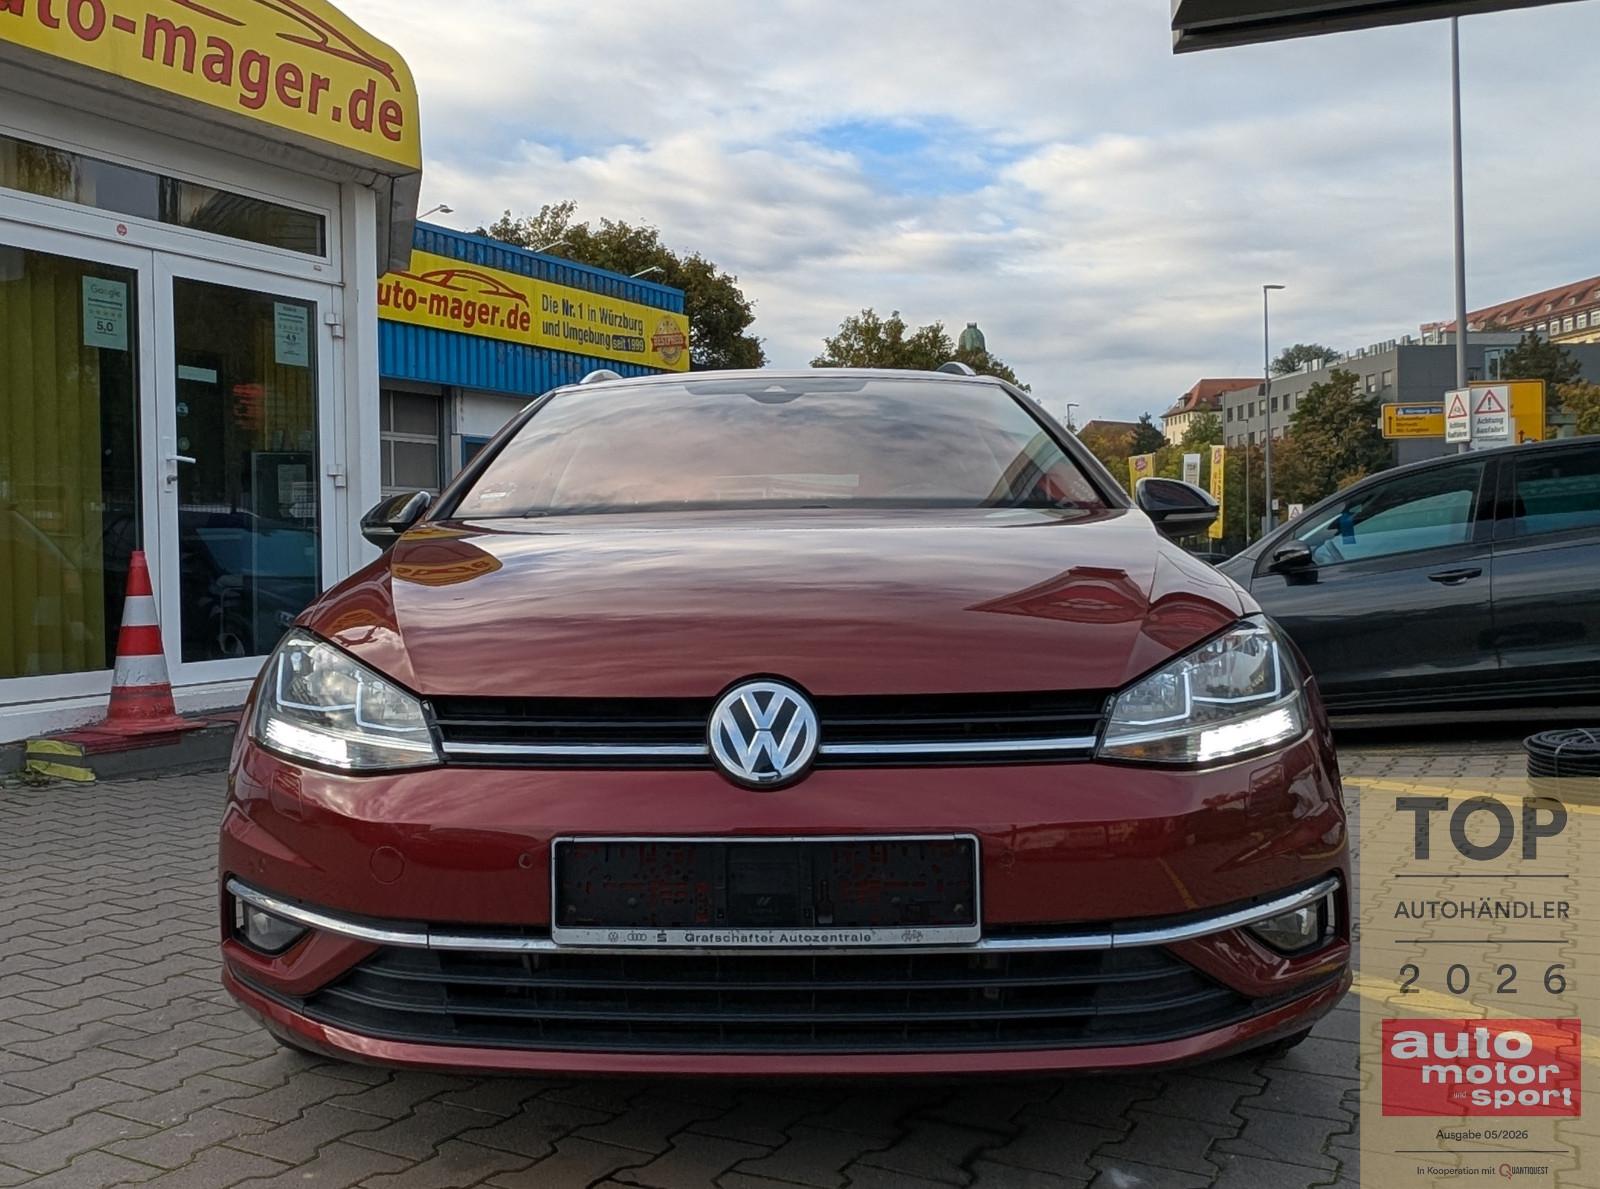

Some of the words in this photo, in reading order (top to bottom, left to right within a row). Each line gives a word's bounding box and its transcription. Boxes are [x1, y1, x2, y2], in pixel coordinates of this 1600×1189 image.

[541, 294, 559, 314] Die
[561, 298, 576, 318] Nr.
[578, 303, 584, 319] 1
[587, 304, 597, 322] in
[599, 307, 644, 336] Würzburg
[542, 320, 560, 337] und
[562, 321, 611, 350] Umgebung
[612, 338, 626, 351] seit
[626, 337, 645, 352] 1999
[1477, 417, 1504, 425] Achtung
[684, 932, 775, 943] Grafschafter
[779, 932, 872, 943] Autozentrale
